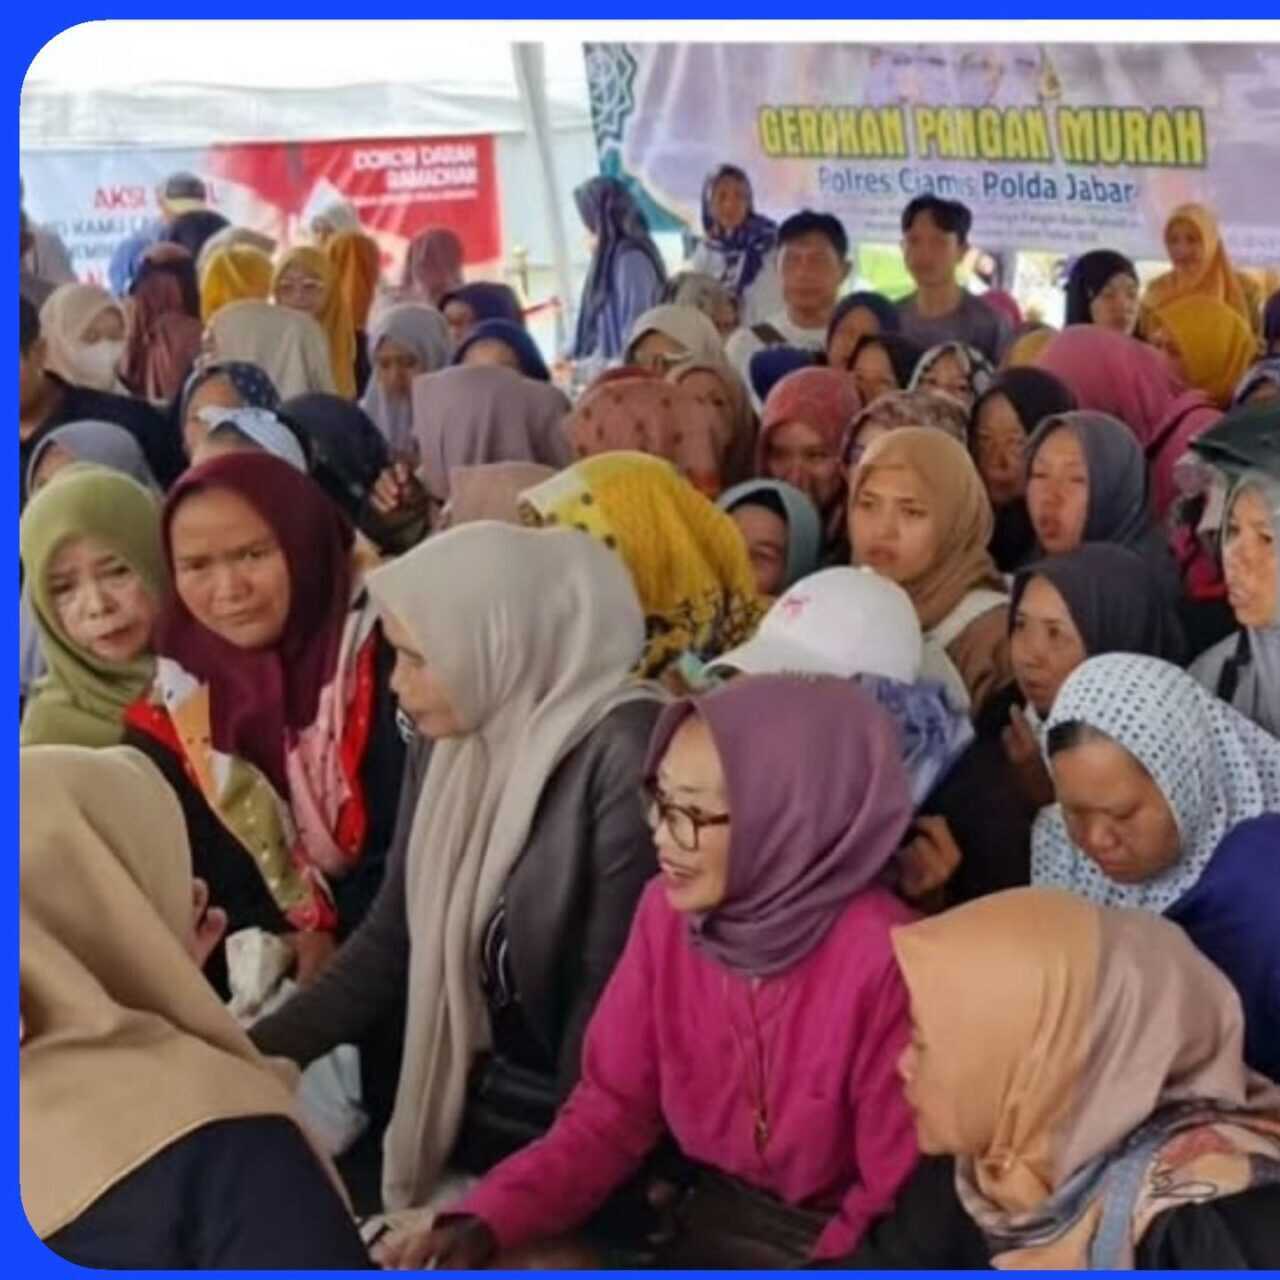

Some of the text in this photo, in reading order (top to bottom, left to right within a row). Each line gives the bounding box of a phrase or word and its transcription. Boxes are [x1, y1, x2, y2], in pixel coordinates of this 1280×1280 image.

[759, 105, 1207, 168] GERAKAN PANGAN MURAH
[983, 172, 1057, 199] Polda
[1066, 173, 1134, 203] Jabar
